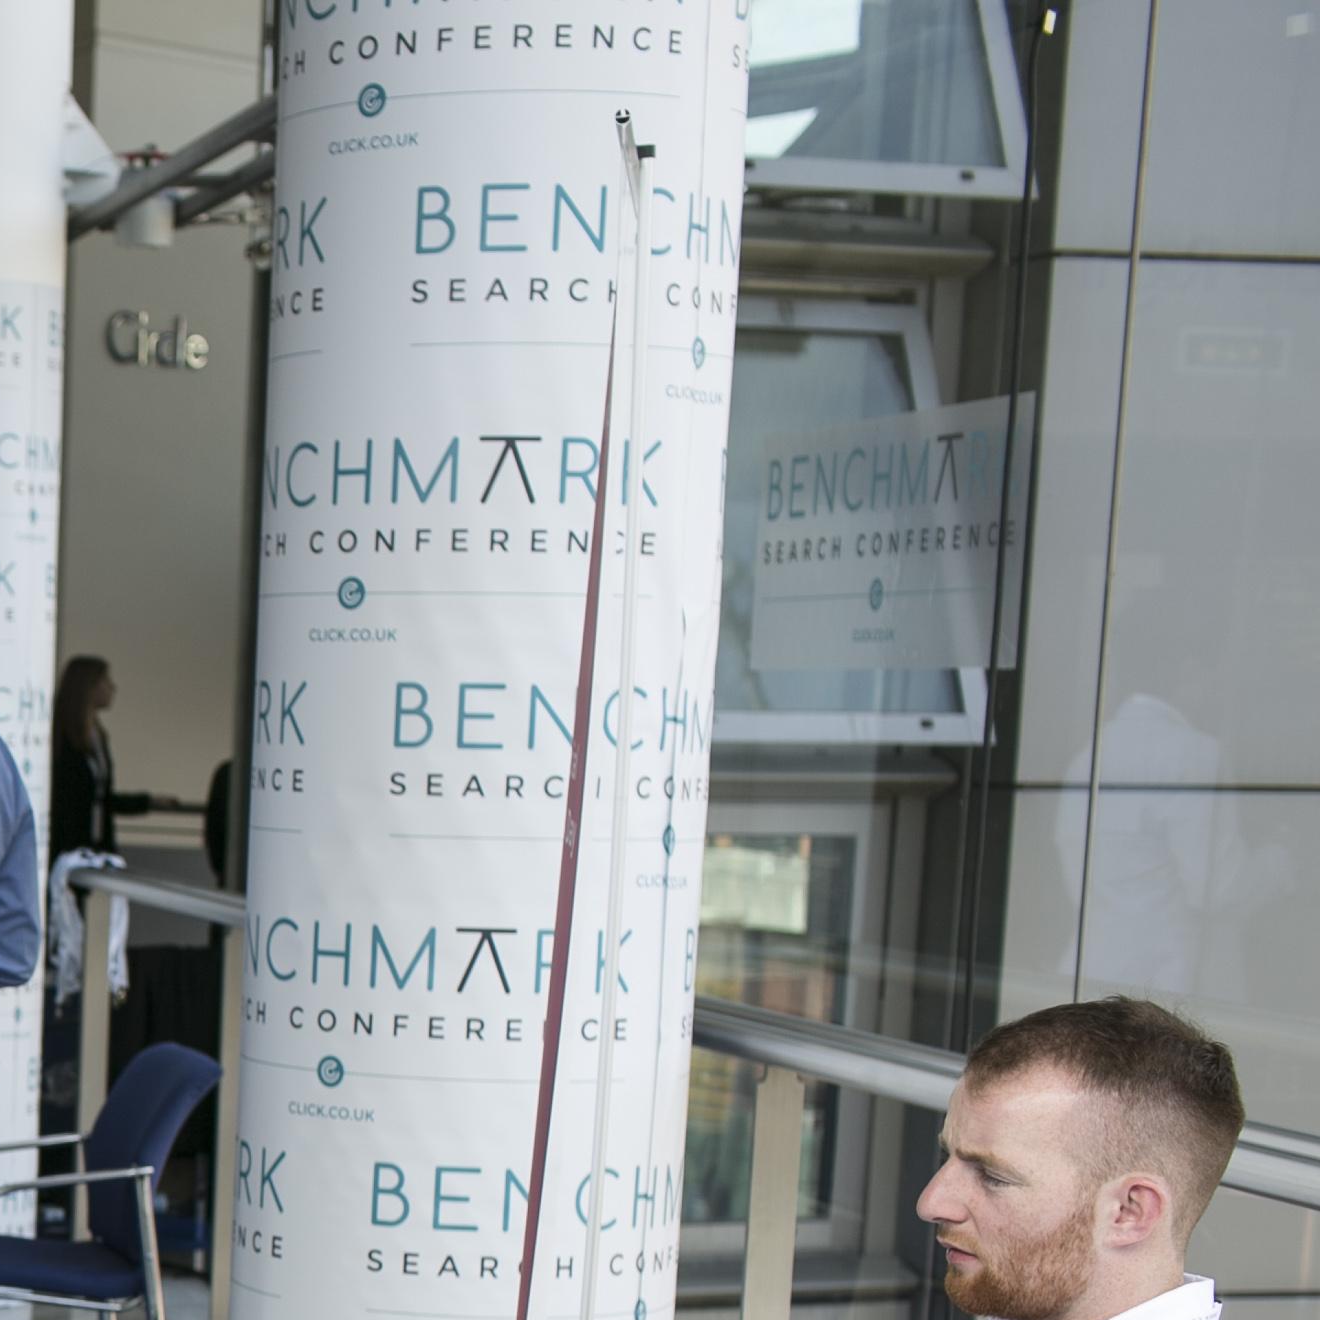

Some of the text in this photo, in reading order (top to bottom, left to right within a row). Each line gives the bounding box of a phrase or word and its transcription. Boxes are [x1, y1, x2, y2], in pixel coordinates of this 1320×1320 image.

[328, 24, 683, 66] CONFERENCE
[327, 131, 420, 156] CLICK.CO.UK
[763, 521, 1016, 567] SEARCH CONFERENCE
[308, 628, 398, 643] CLICK.CO.UK
[288, 1006, 628, 1043] CONFERECE
[288, 1101, 375, 1123] CLICK.CO.UK
[366, 1248, 573, 1280] SEARH
